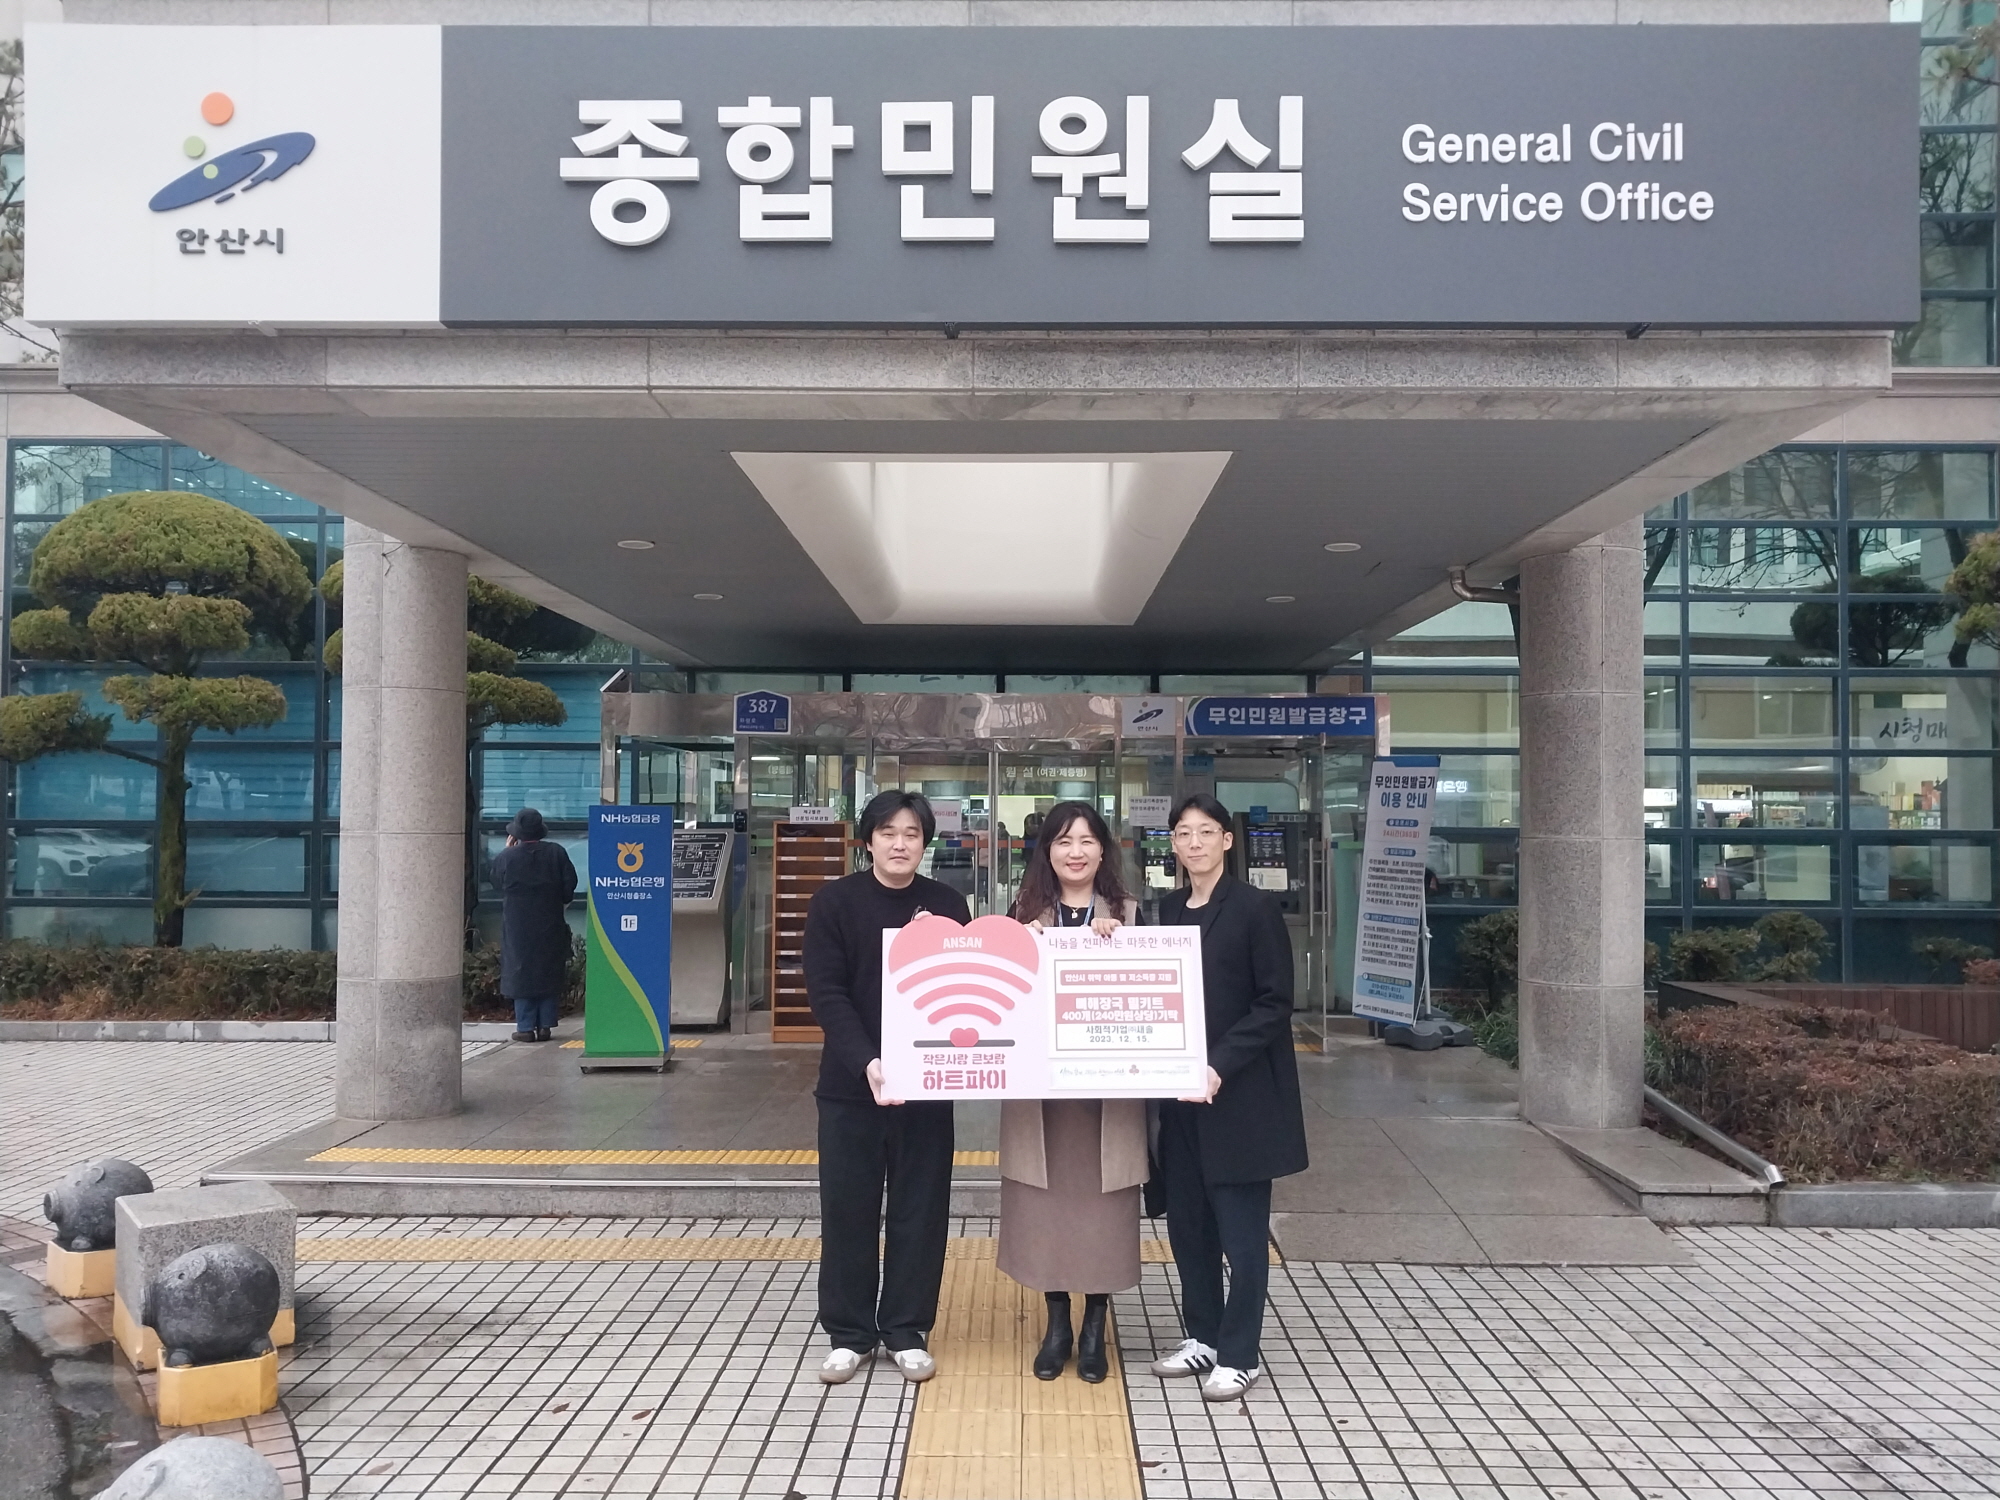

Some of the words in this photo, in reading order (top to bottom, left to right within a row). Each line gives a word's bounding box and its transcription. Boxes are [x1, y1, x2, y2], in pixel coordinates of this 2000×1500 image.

[1401, 123, 1572, 164] General
[1589, 121, 1684, 162] Civil
[558, 95, 1305, 247] 종합민원실
[1401, 182, 1564, 223] Service
[1580, 181, 1715, 223] Office
[175, 227, 285, 255] 안산시
[748, 699, 777, 714] 387
[1208, 707, 1367, 725] 무인민원발급창구
[1374, 775, 1436, 790] 무인민원발급기
[1380, 791, 1402, 809] 이용
[1406, 792, 1428, 809] 안내
[601, 813, 661, 824] NH농협금융
[595, 876, 665, 888] NH농협은행
[623, 918, 636, 928] 1F
[942, 937, 983, 949] ANSAN
[1048, 937, 1078, 950] 나눔을
[1082, 936, 1123, 949] 전파하는
[1127, 936, 1159, 949] 따뜻한
[1161, 936, 1192, 948] 에너지
[1064, 973, 1086, 982] 안산시
[1127, 997, 1165, 1010] 밀키트
[1089, 1035, 1114, 1043] 2023.
[922, 1053, 969, 1065] 작은사랑
[972, 1053, 1006, 1065] 큰보람
[922, 1069, 1006, 1090] 하트파이
